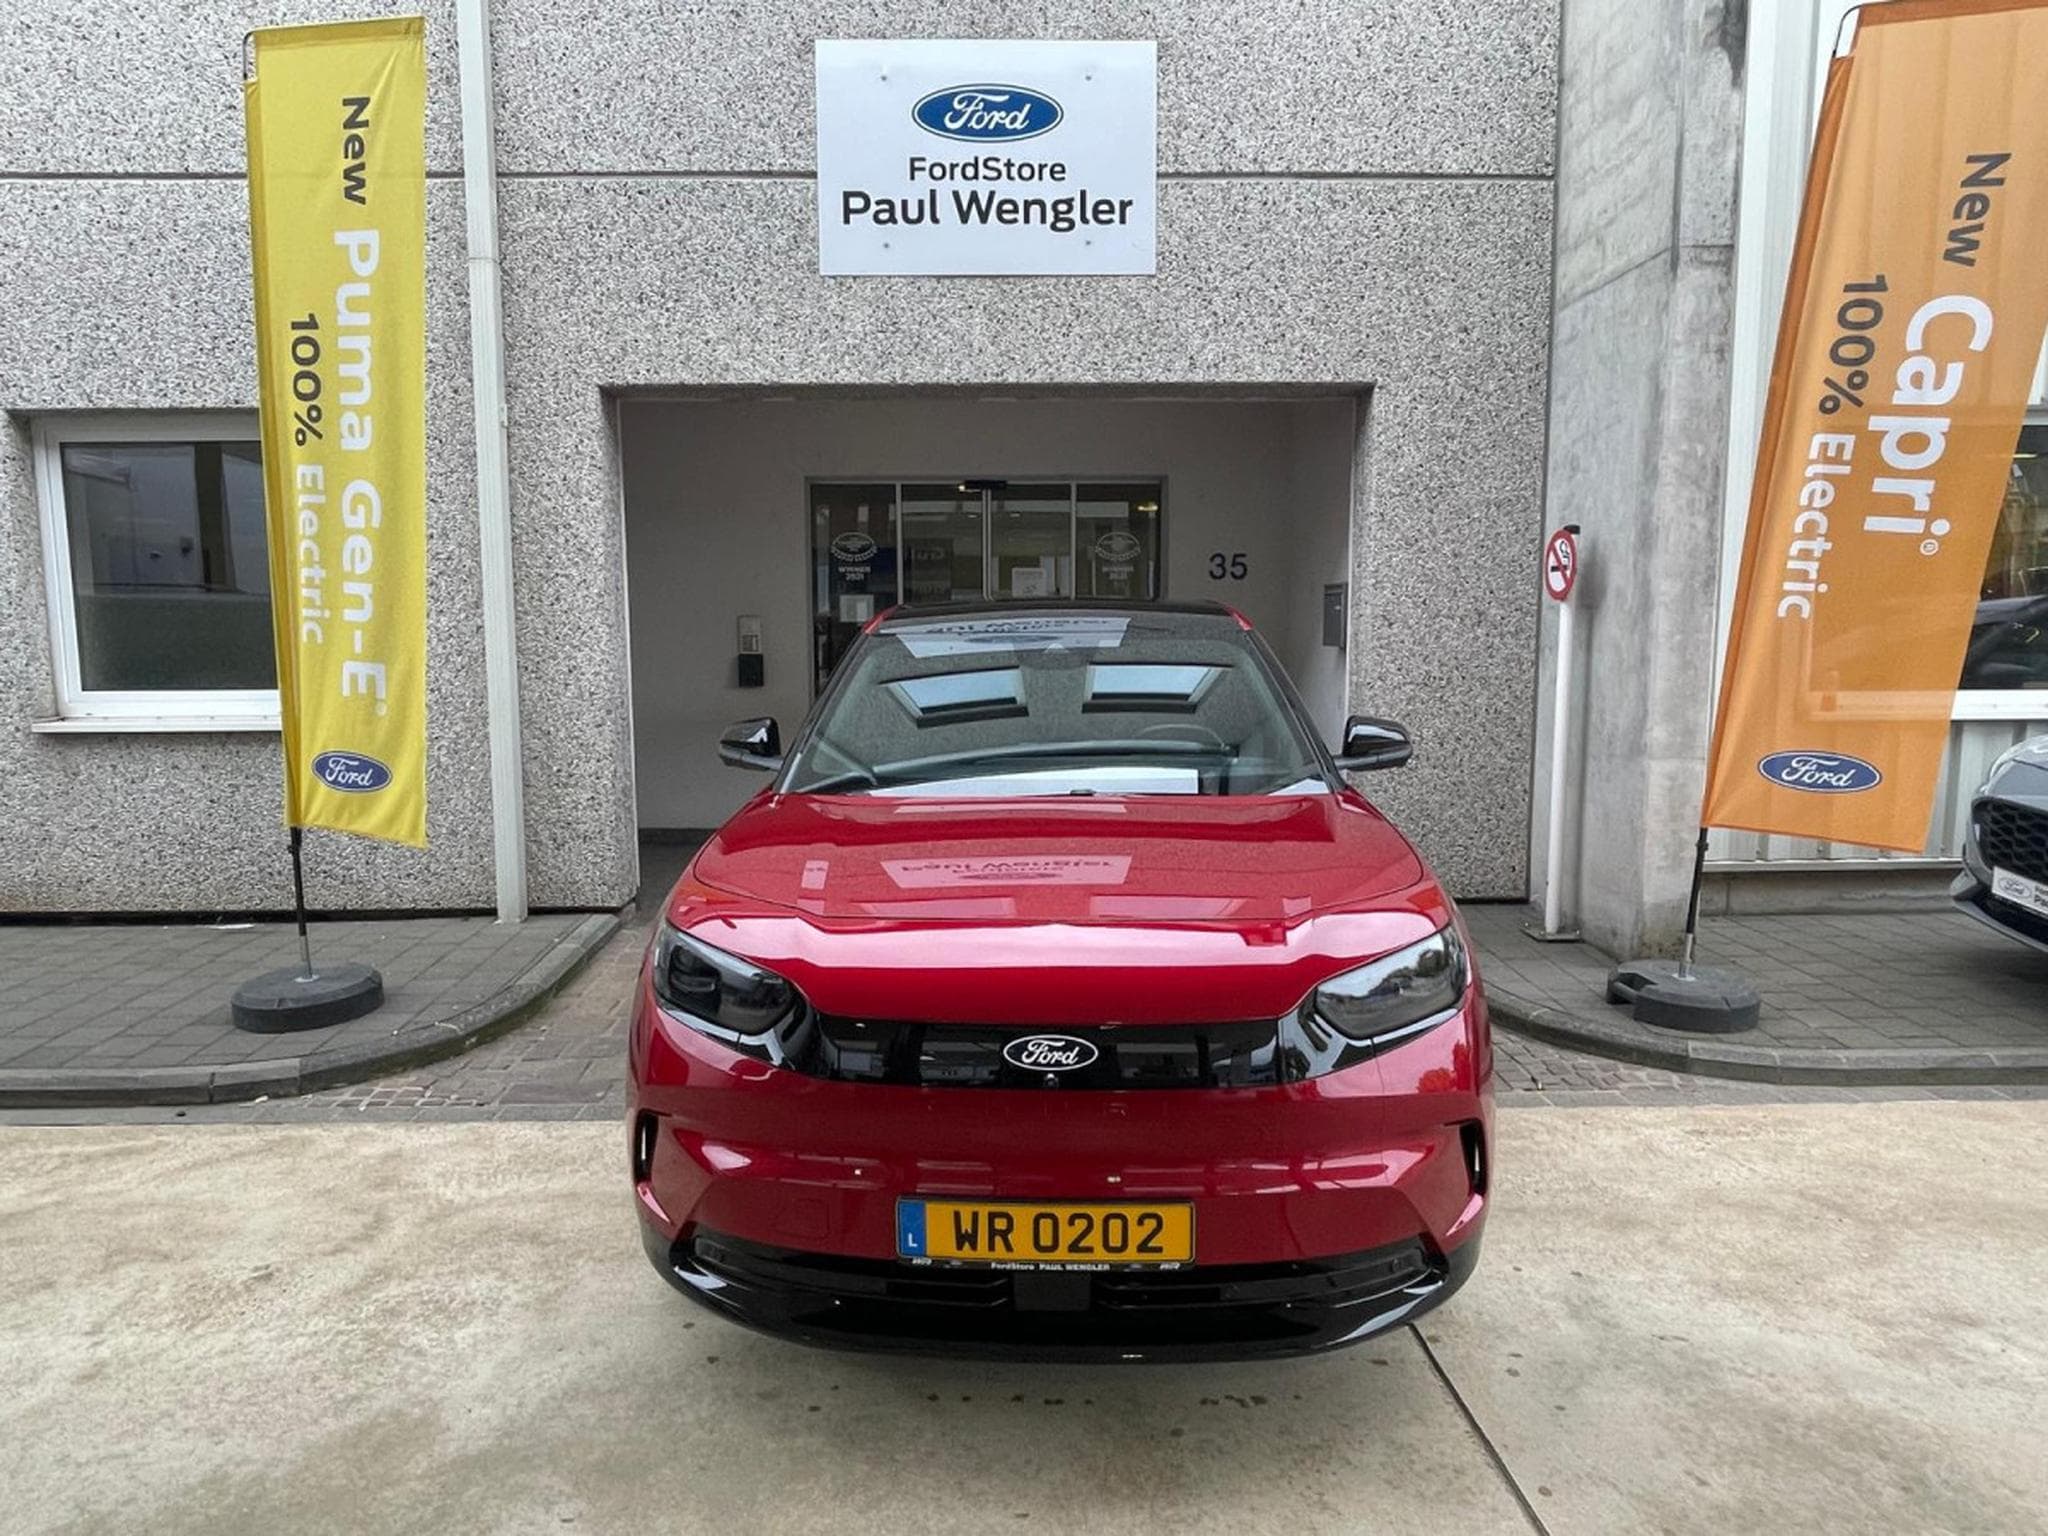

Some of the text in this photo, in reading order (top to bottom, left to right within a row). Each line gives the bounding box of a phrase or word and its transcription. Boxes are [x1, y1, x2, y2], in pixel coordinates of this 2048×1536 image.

[944, 91, 1032, 131] Ford
[342, 96, 371, 206] New
[909, 156, 1067, 182] FordStore
[842, 189, 1134, 233] Paul Wengler
[1942, 153, 2012, 267] New
[334, 229, 380, 452] Puma
[1777, 274, 1889, 620] 100% Electric
[290, 312, 331, 645] 100% Electric
[1208, 553, 1248, 581] 35
[325, 757, 373, 787] Ford
[1781, 755, 1853, 788] Ford
[1021, 1039, 1080, 1065] Ford
[907, 1232, 919, 1248] L
[953, 1209, 1165, 1254] WR 0202
